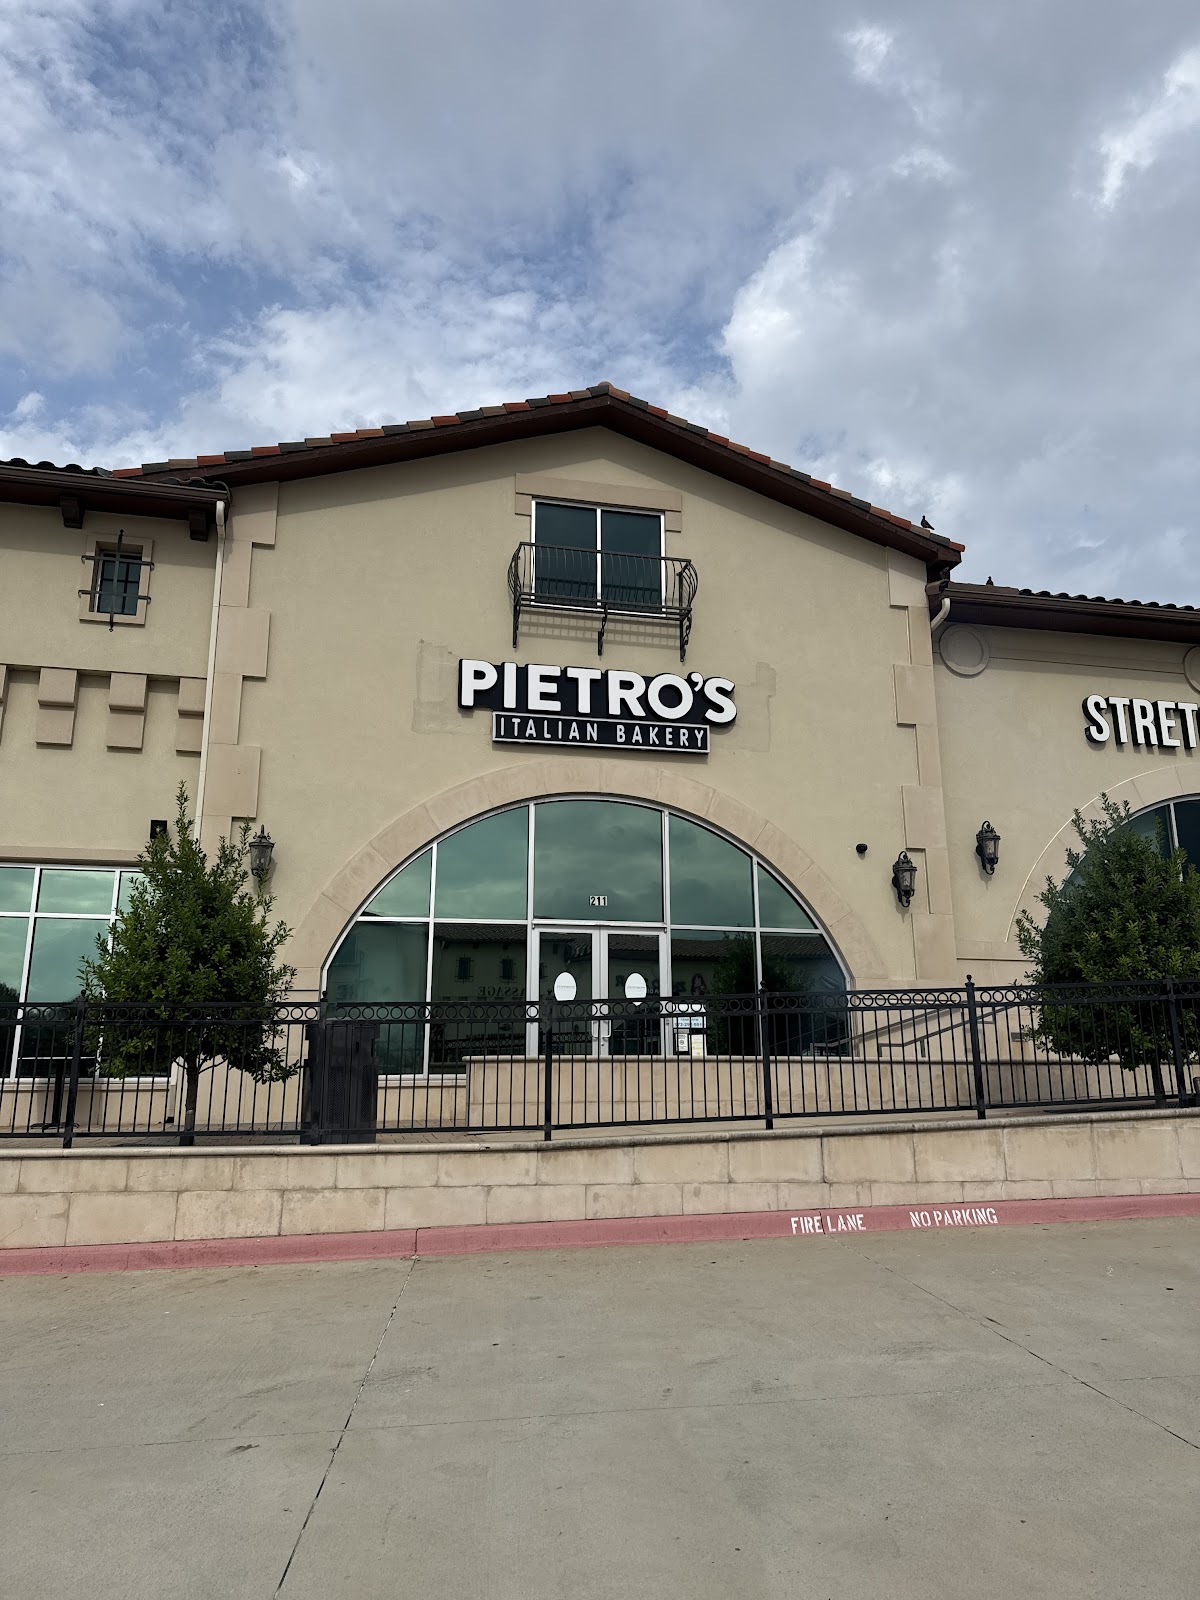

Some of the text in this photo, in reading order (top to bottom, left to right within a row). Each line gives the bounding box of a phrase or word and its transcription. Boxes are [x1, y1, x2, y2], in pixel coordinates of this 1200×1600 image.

[460, 659, 738, 724] PIETRO'S
[500, 717, 705, 748] ITALIAN BAKERY
[1084, 693, 1200, 749] STRET
[590, 896, 606, 906] 211
[790, 1213, 867, 1235] FIRE LANE
[909, 1207, 999, 1228] NO PARKING
